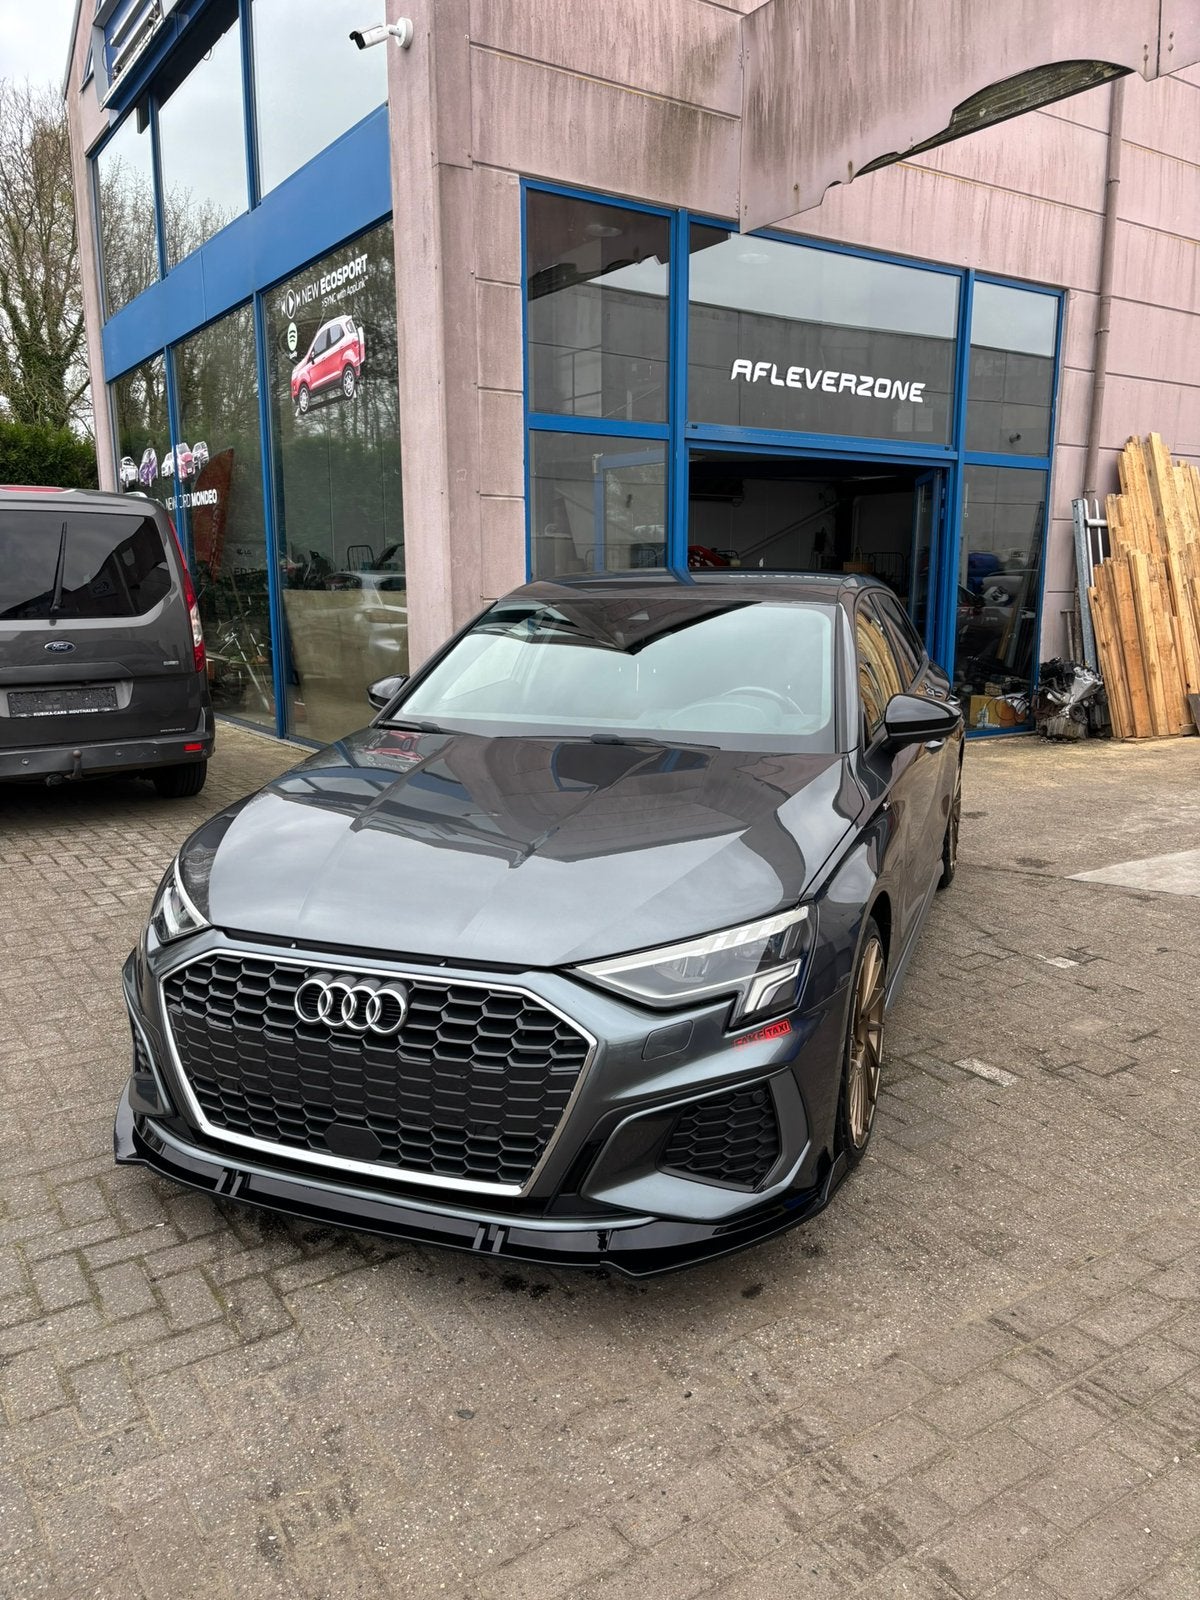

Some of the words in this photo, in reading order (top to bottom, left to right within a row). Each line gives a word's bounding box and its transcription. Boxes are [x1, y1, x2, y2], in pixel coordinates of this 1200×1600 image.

[301, 281, 319, 305] NEW
[320, 253, 368, 295] ECOSPORT
[730, 358, 926, 403] AFLEVERZONE
[191, 488, 218, 507] MONDEO
[766, 1020, 789, 1036] TAXI
